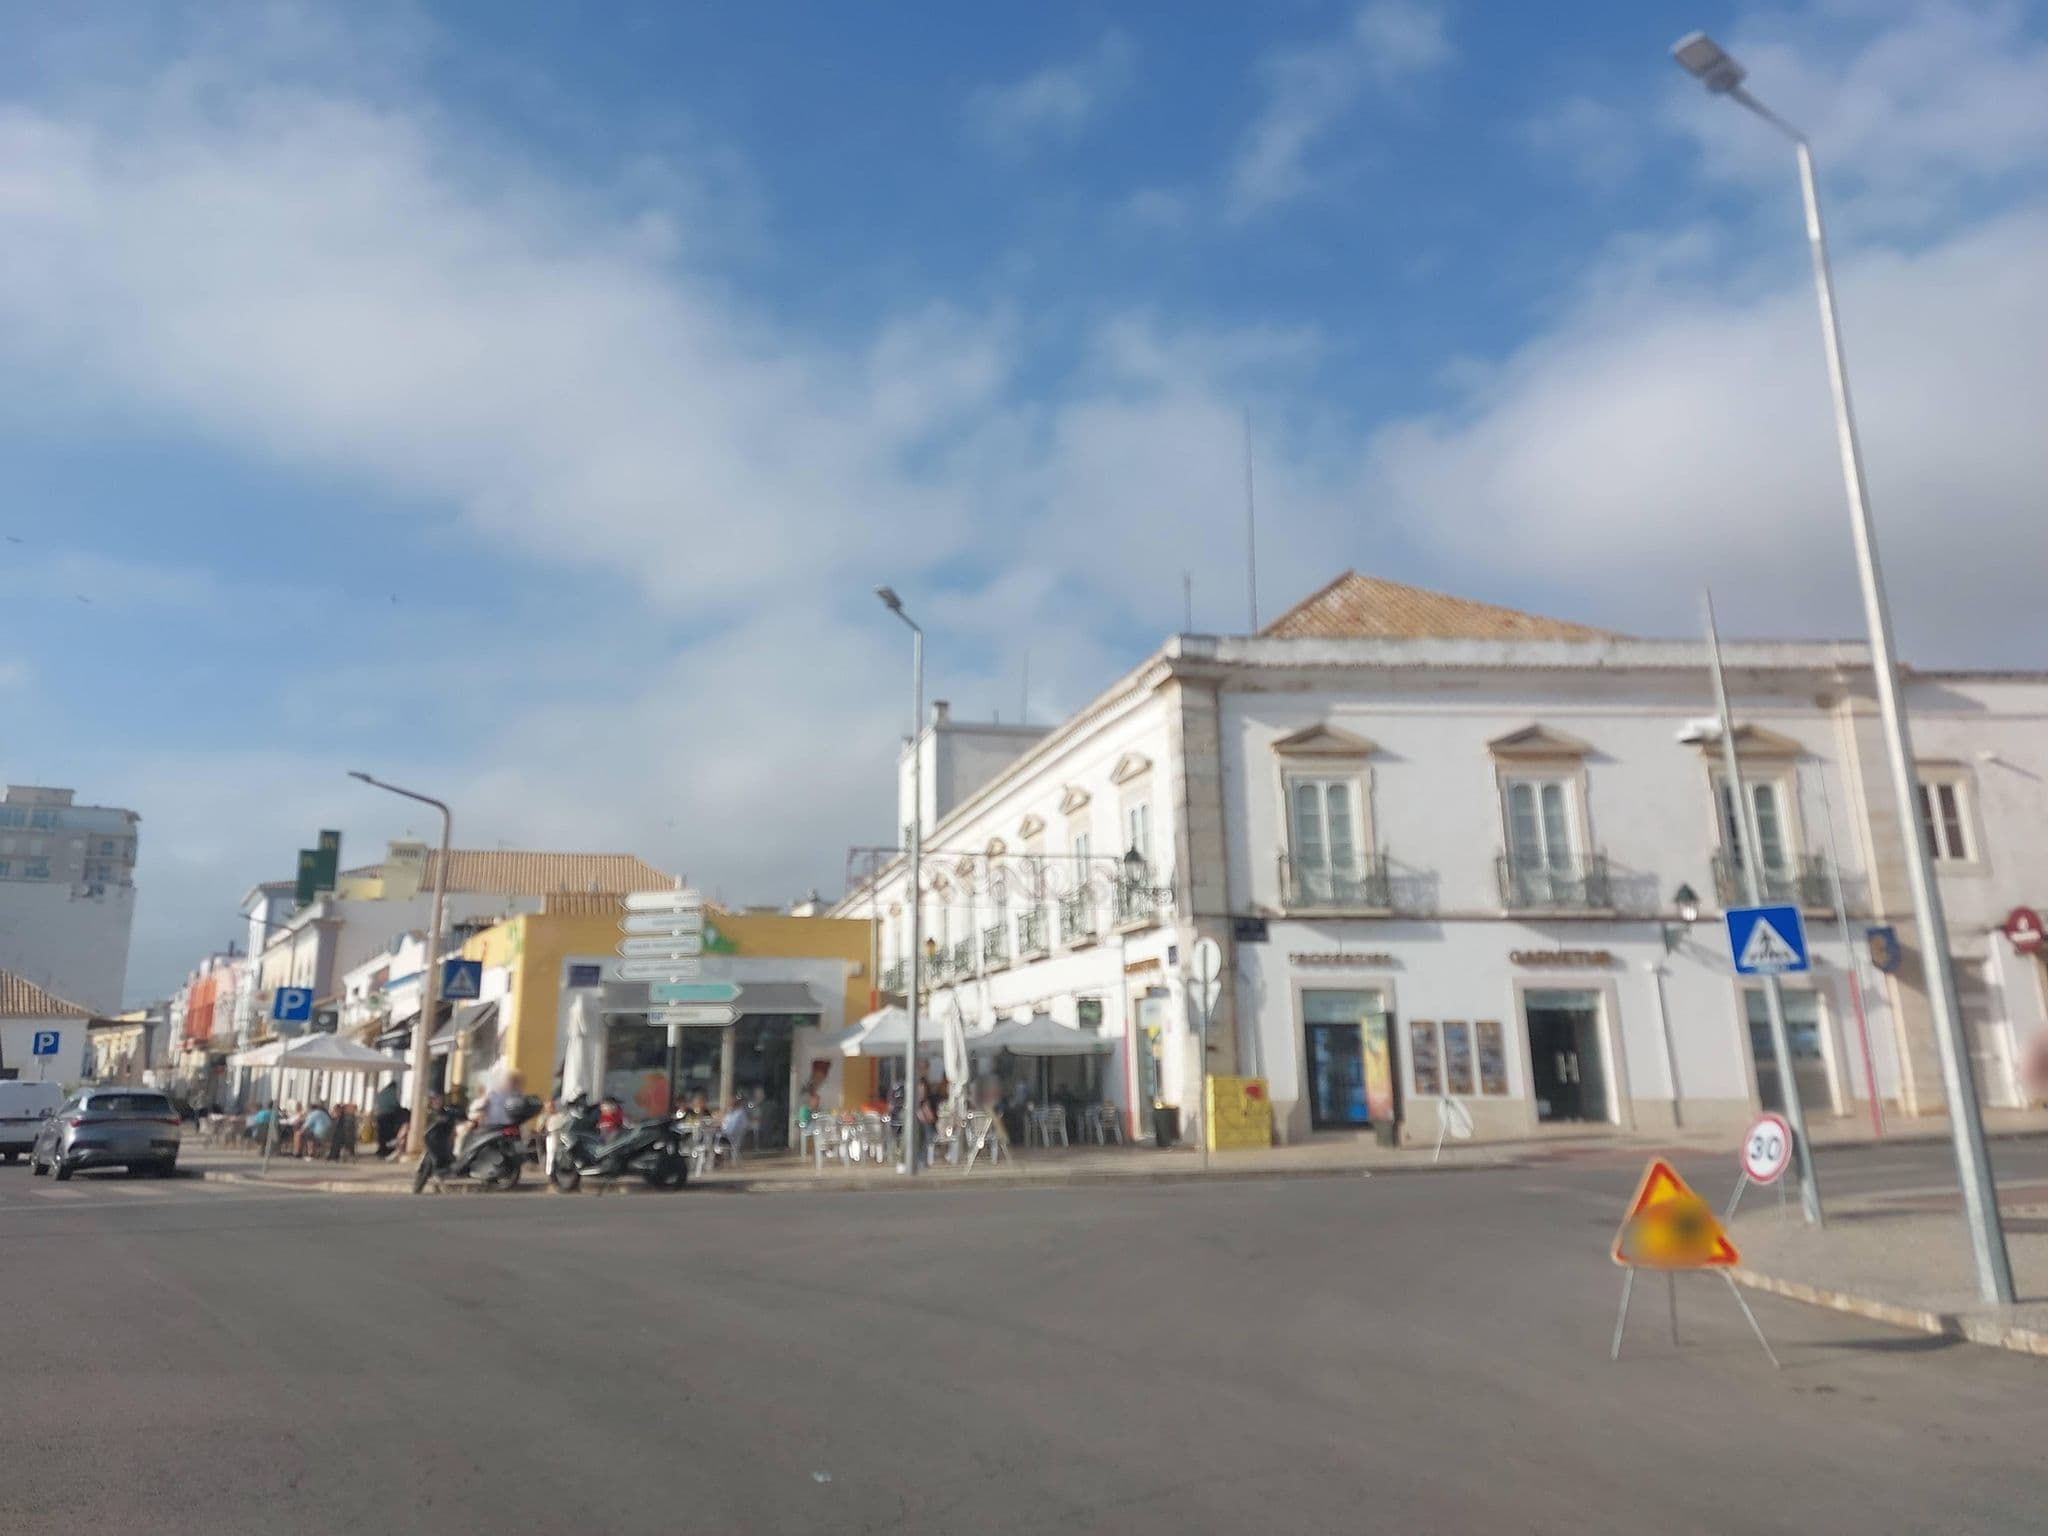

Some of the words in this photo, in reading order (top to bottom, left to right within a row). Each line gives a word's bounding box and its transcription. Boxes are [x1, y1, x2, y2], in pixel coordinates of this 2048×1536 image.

[280, 990, 306, 1017] P
[38, 1033, 55, 1053] P
[1751, 1136, 1780, 1160] 30
